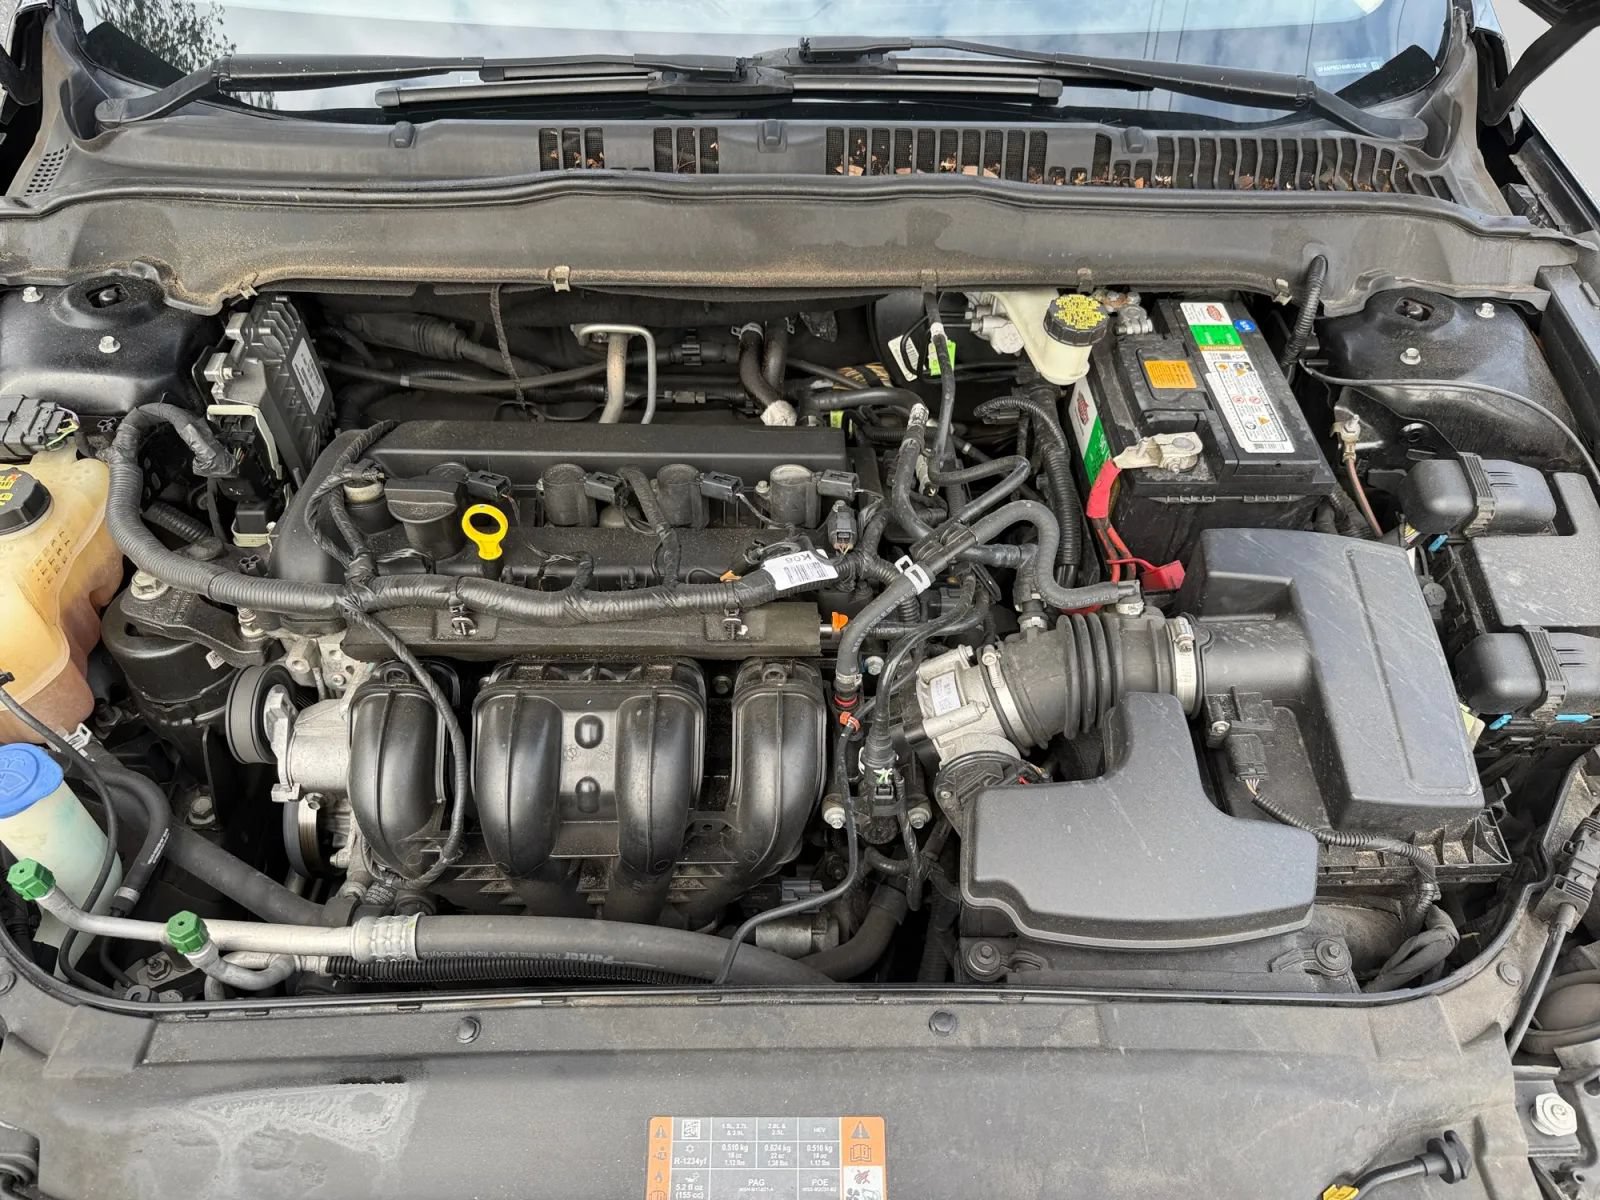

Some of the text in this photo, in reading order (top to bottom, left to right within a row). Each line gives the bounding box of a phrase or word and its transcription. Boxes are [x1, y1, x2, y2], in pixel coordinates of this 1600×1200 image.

[563, 952, 614, 964] Parker
[739, 1144, 749, 1153] kg
[782, 1144, 791, 1153] kg
[824, 1144, 833, 1153] kg
[673, 1157, 707, 1167] R-1234yf
